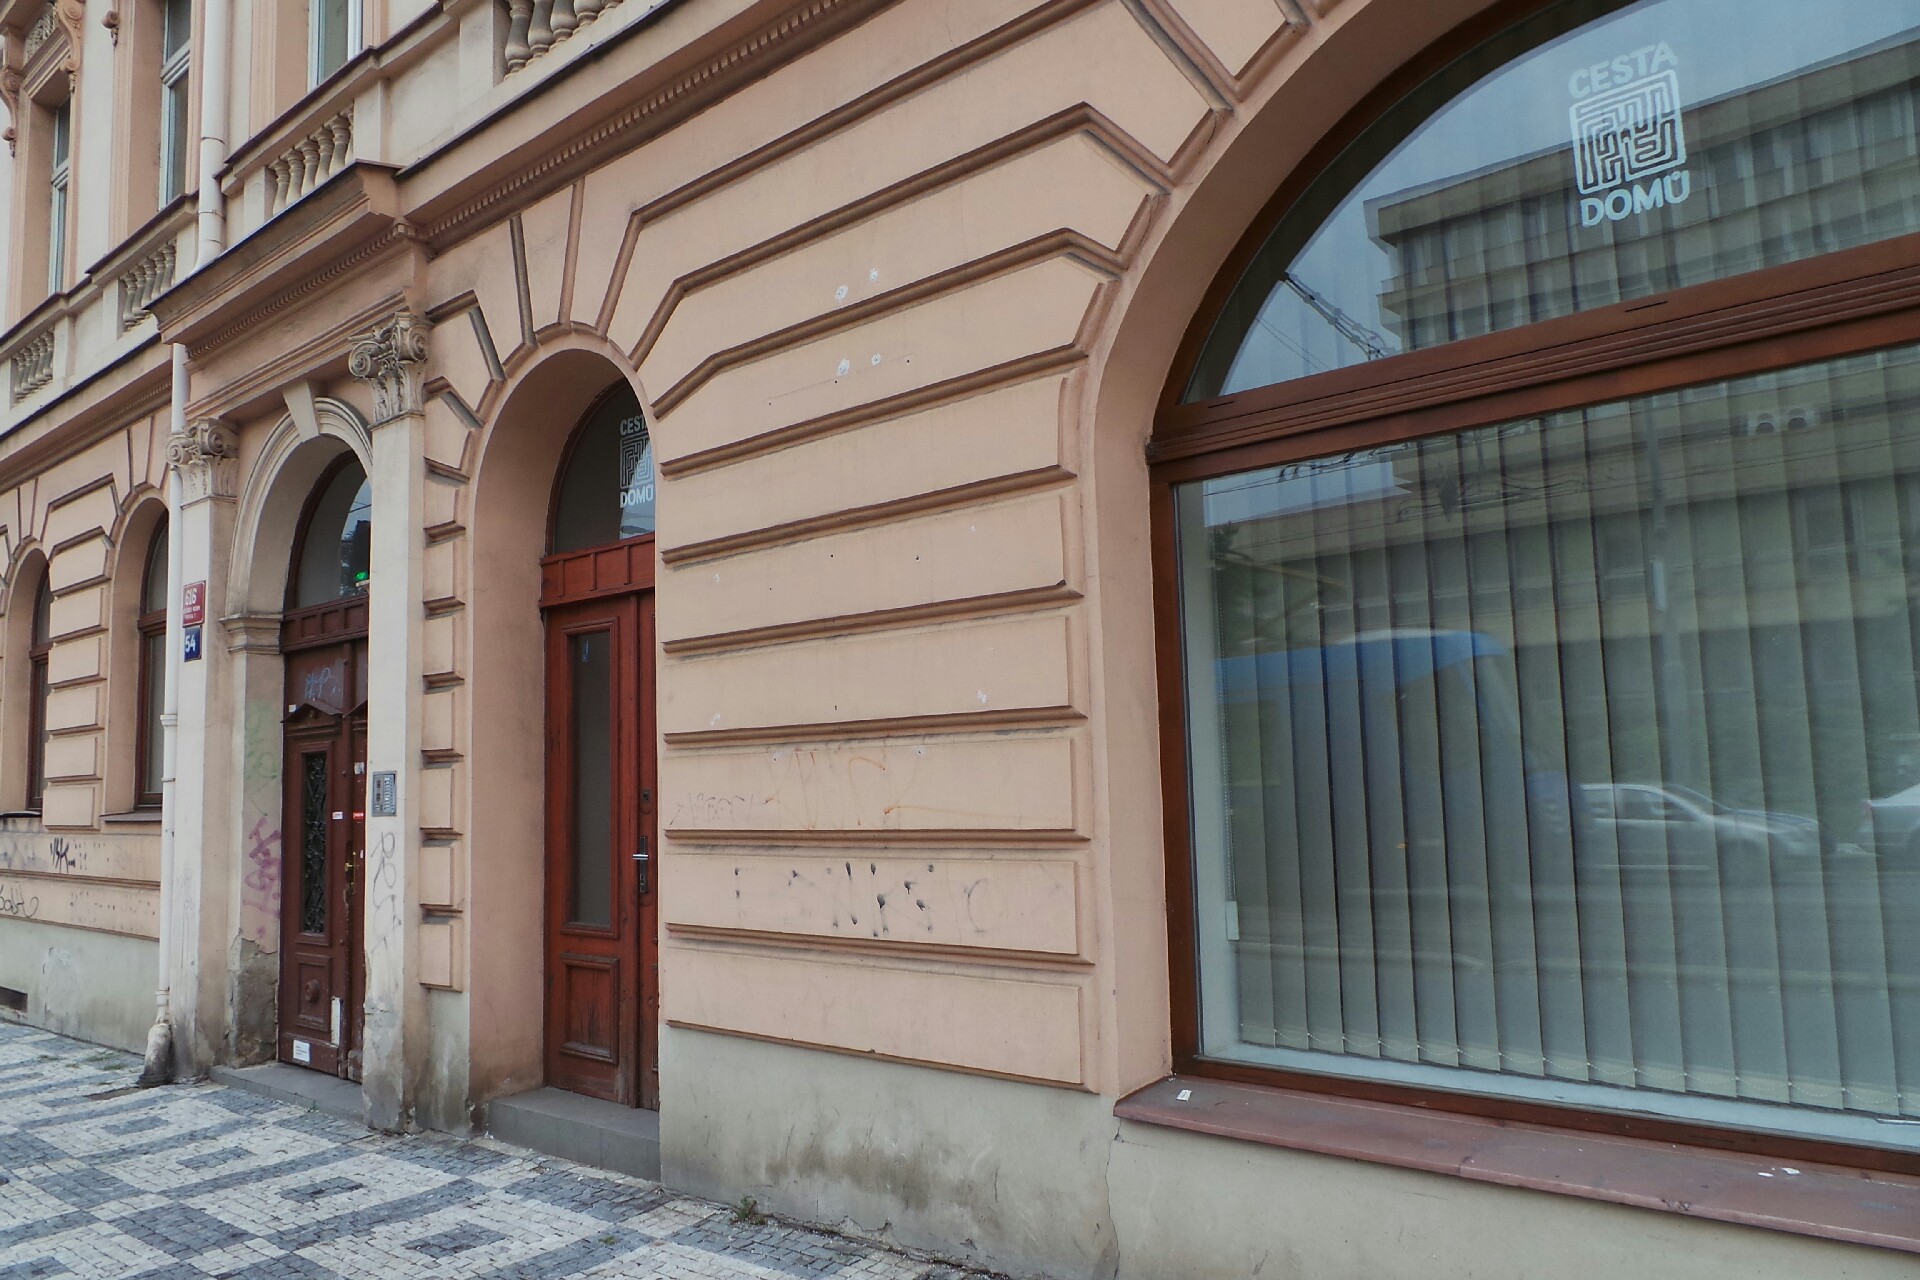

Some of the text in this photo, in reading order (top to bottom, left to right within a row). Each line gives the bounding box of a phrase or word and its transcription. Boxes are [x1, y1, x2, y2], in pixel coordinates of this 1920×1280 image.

[1569, 40, 1678, 99] CESTA
[1580, 170, 1690, 228] DOMŮ
[620, 414, 647, 435] CEST
[185, 635, 196, 653] 54
